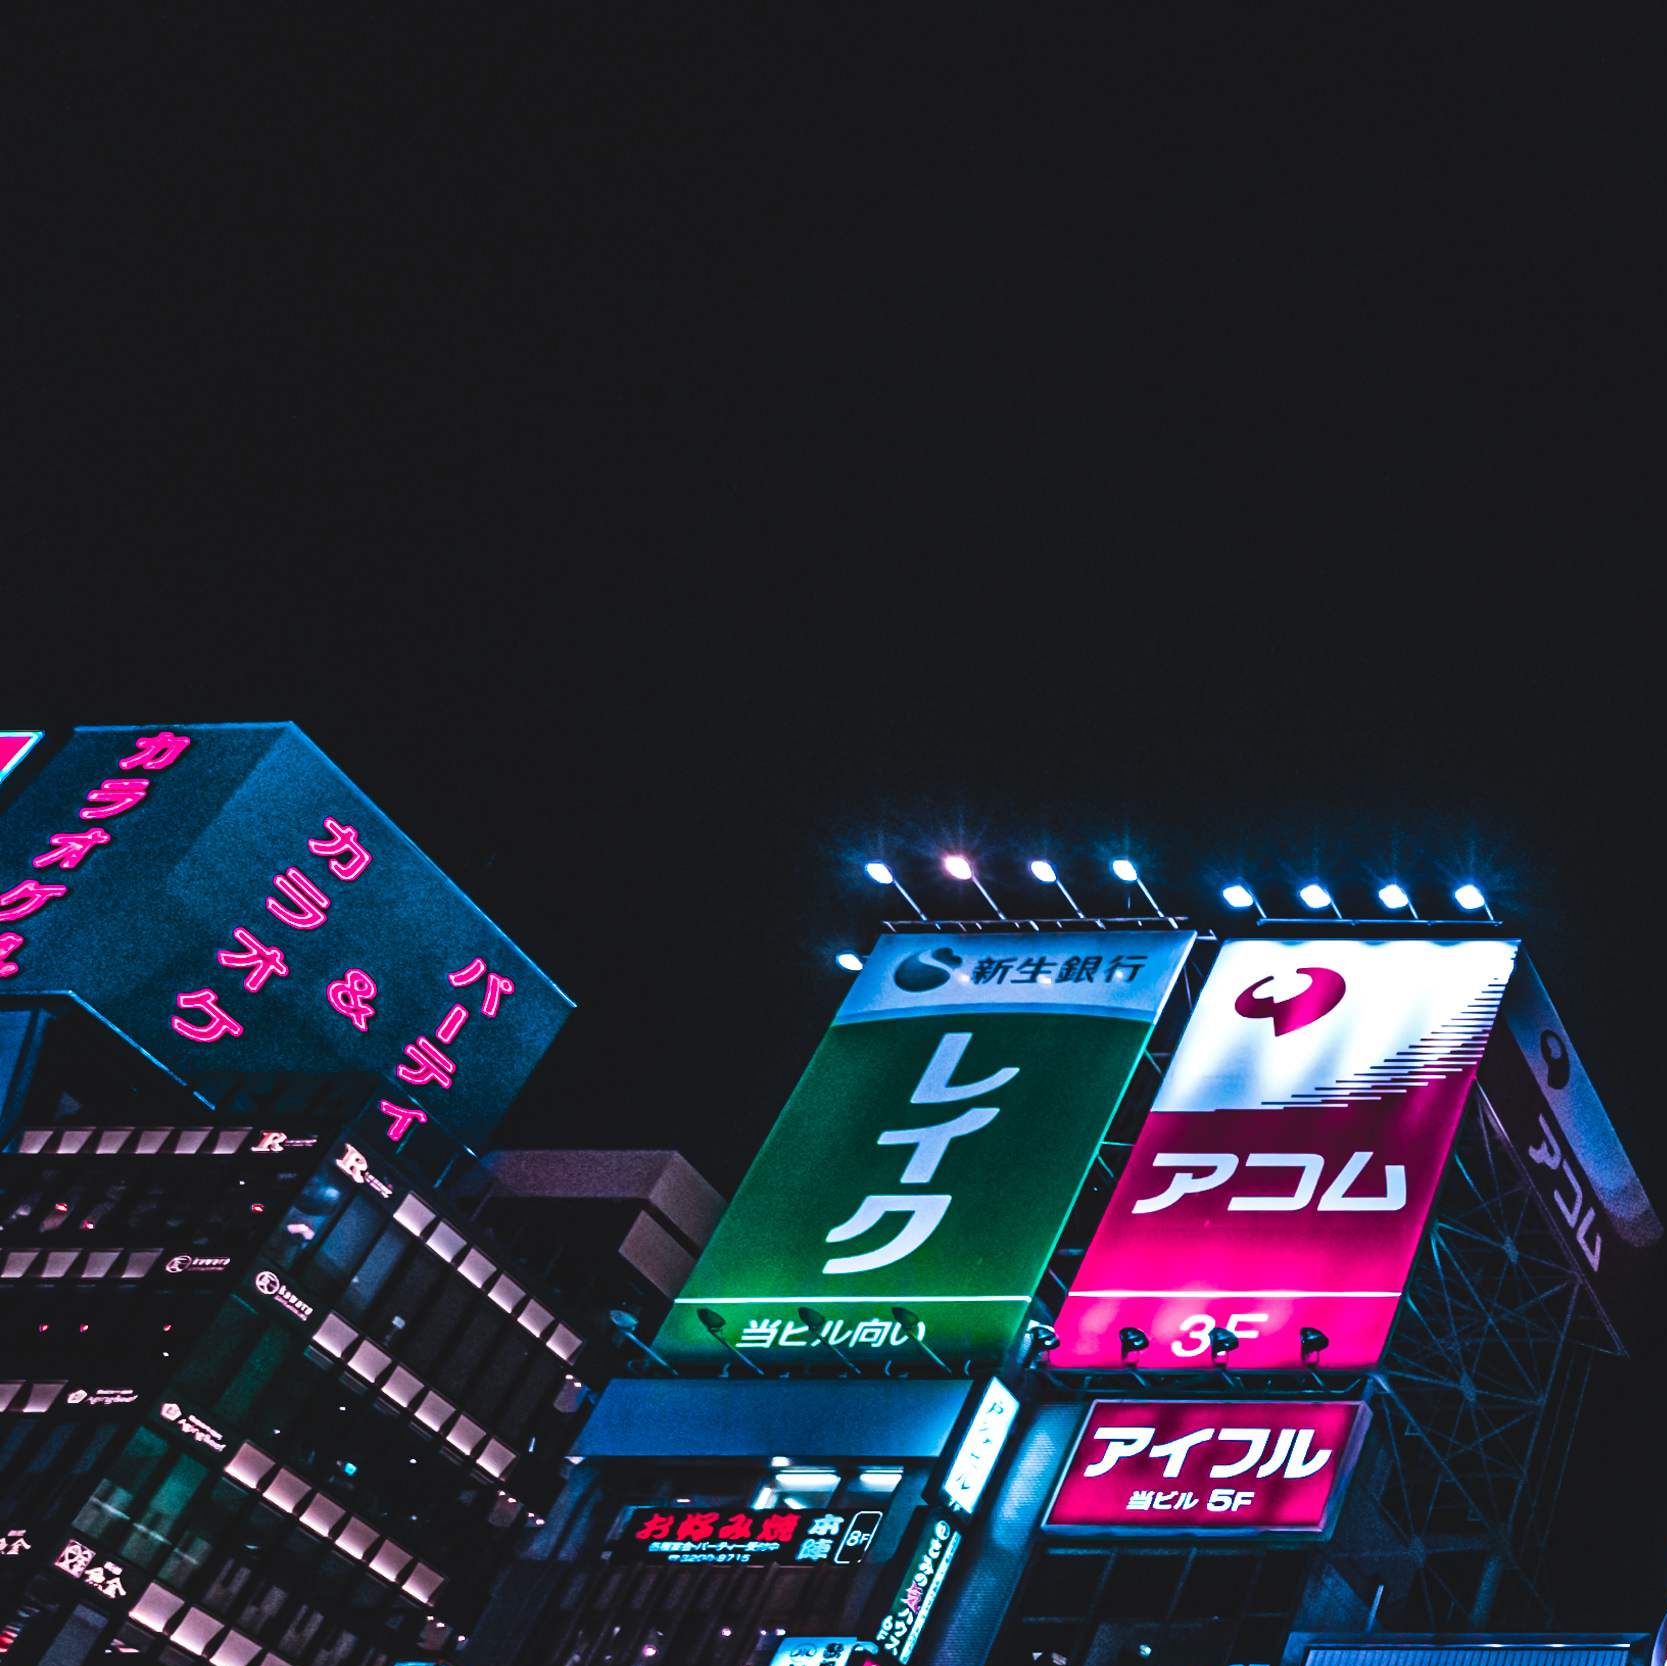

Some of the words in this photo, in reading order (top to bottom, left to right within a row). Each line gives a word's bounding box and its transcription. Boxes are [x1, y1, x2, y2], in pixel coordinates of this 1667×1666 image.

[171, 816, 371, 1043] カラオケ
[326, 968, 378, 1031] &
[971, 955, 1150, 987] 新生銀行
[822, 1031, 1021, 1275] レイク
[1131, 1151, 1408, 1214] アコム
[1171, 1313, 1268, 1358] 3F
[1084, 1425, 1333, 1485] アイフル
[636, 1512, 801, 1542] お好み焼
[1127, 1489, 1198, 1513] 当ビル
[1206, 1488, 1254, 1514] 5F
